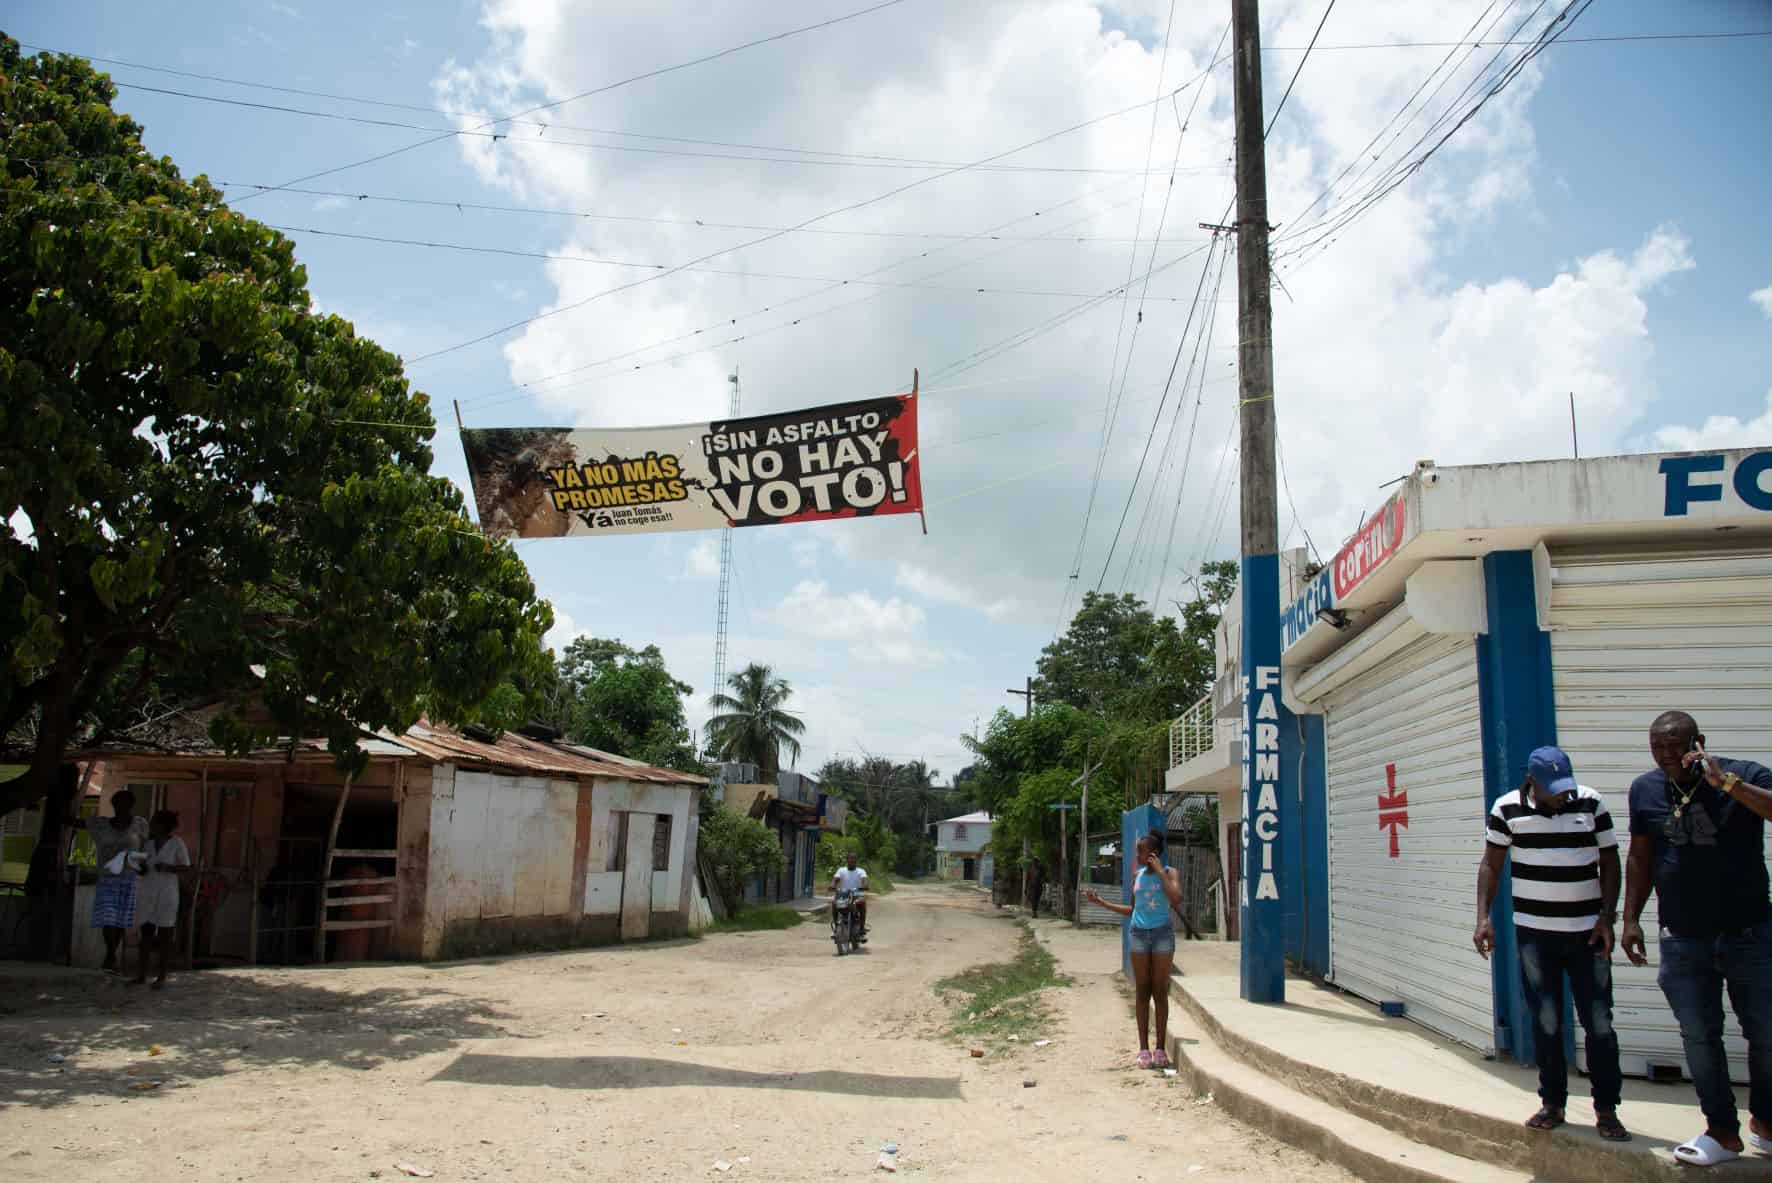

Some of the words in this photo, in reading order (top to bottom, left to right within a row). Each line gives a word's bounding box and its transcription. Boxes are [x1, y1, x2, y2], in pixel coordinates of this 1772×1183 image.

[766, 412, 880, 446] ASFALTO
[550, 463, 583, 489] YÁ
[583, 464, 619, 486] NO
[622, 454, 679, 482] MÁS
[718, 450, 783, 484] NO
[798, 431, 888, 474] HAY
[554, 479, 687, 510] PROMESAS
[710, 460, 907, 520] VOTO!
[577, 511, 614, 528] Yá
[614, 516, 627, 526] no
[627, 515, 650, 526] coge
[633, 506, 662, 517] Tomás
[1255, 665, 1280, 900] FARMACIA
